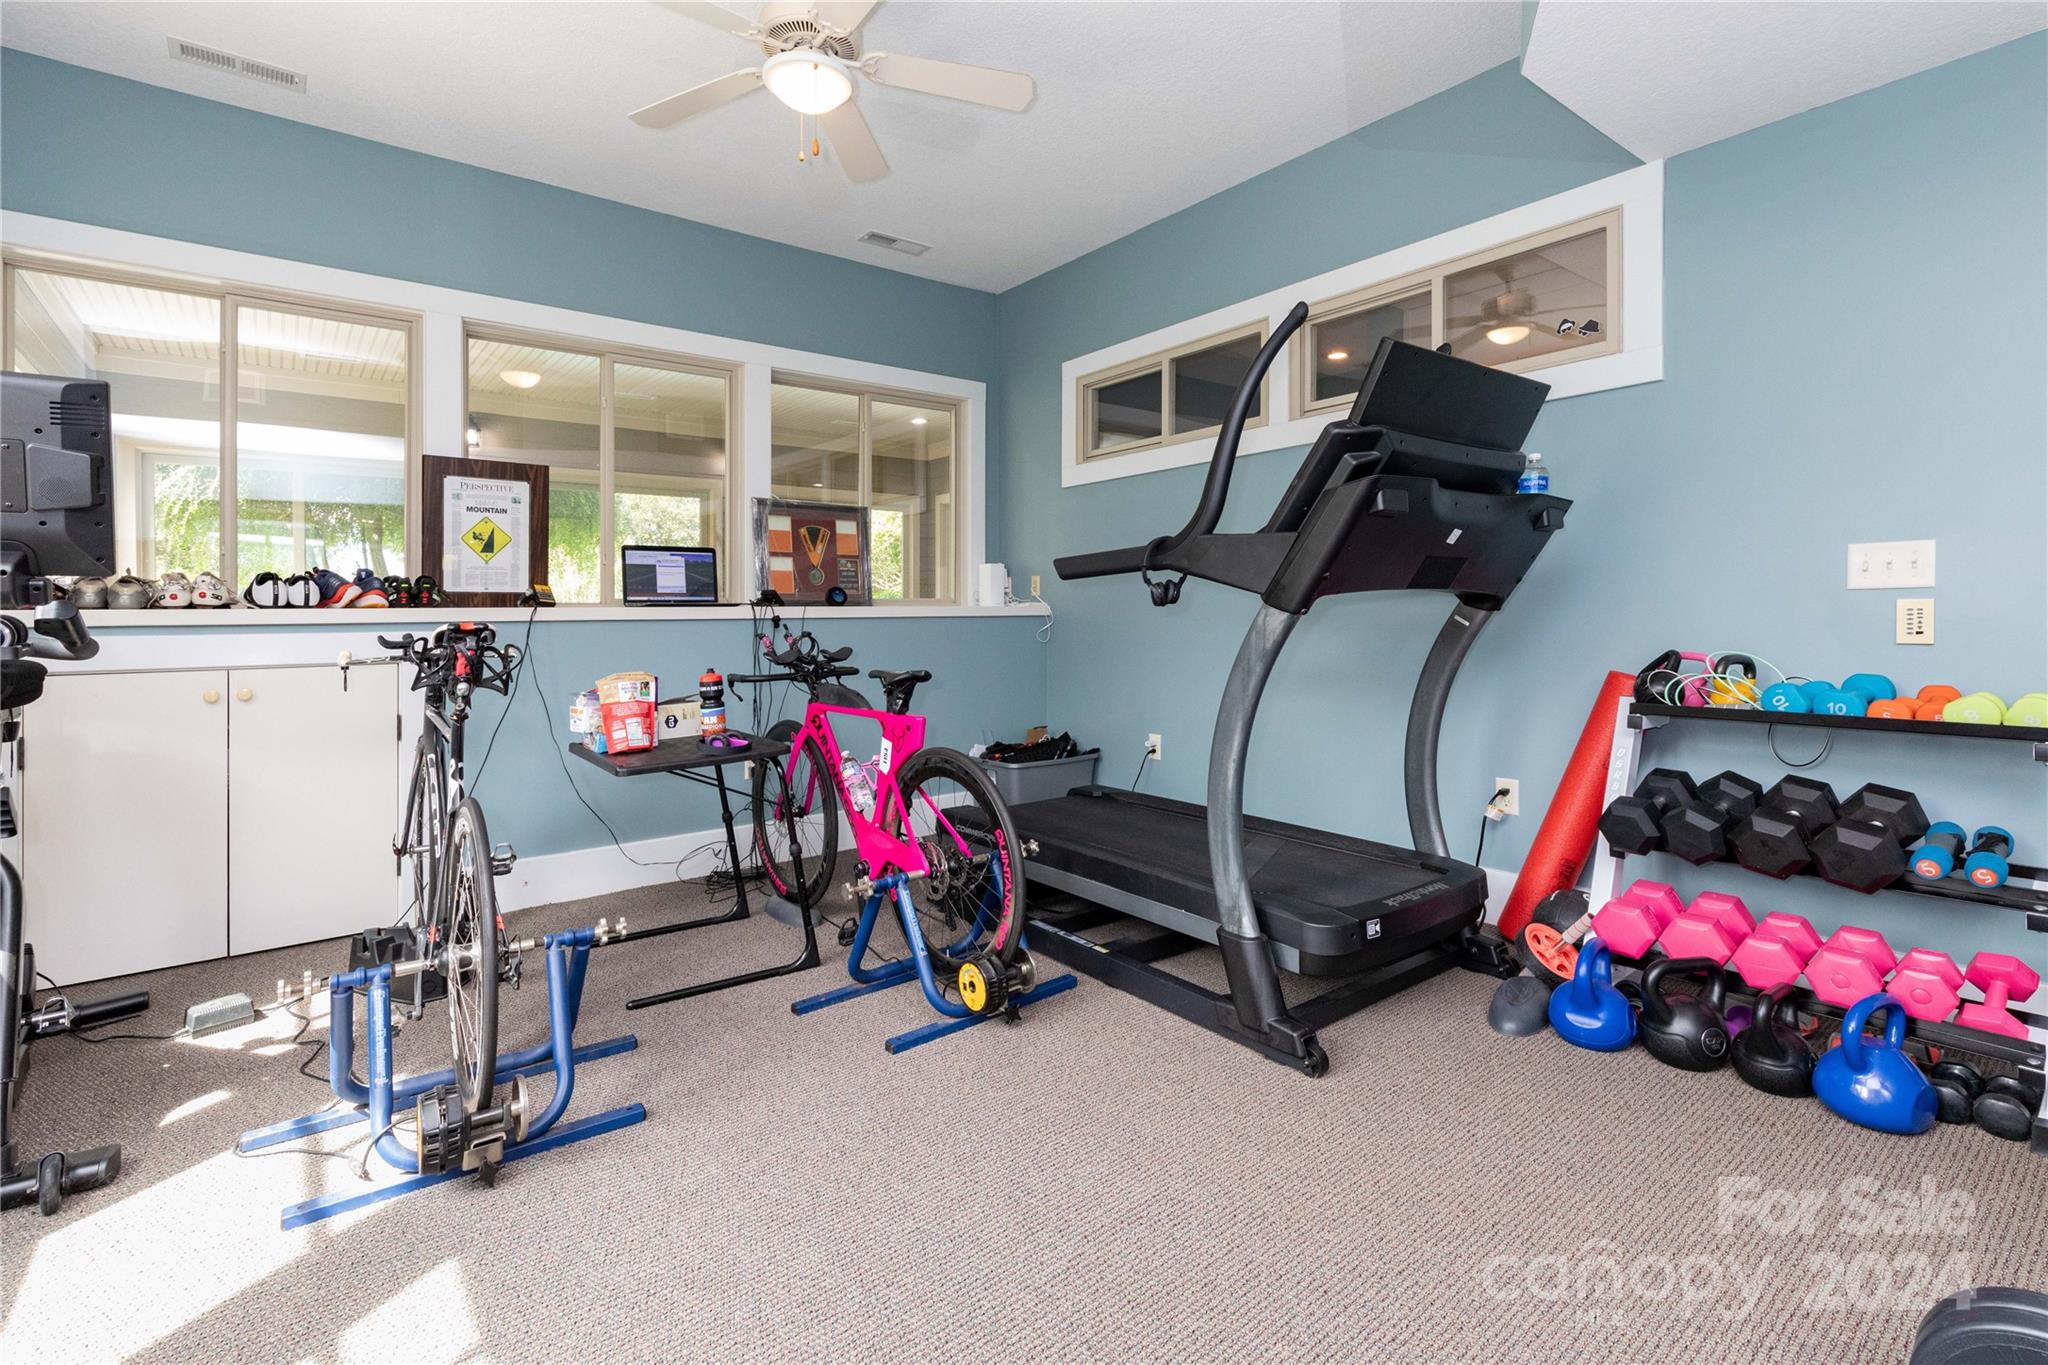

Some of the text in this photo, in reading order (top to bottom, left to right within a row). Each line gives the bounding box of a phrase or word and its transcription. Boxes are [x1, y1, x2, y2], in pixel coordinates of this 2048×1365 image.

[466, 506, 508, 514] MOUNTAIN
[1827, 702, 1847, 715] 10
[993, 828, 1013, 917] QUINTANA
